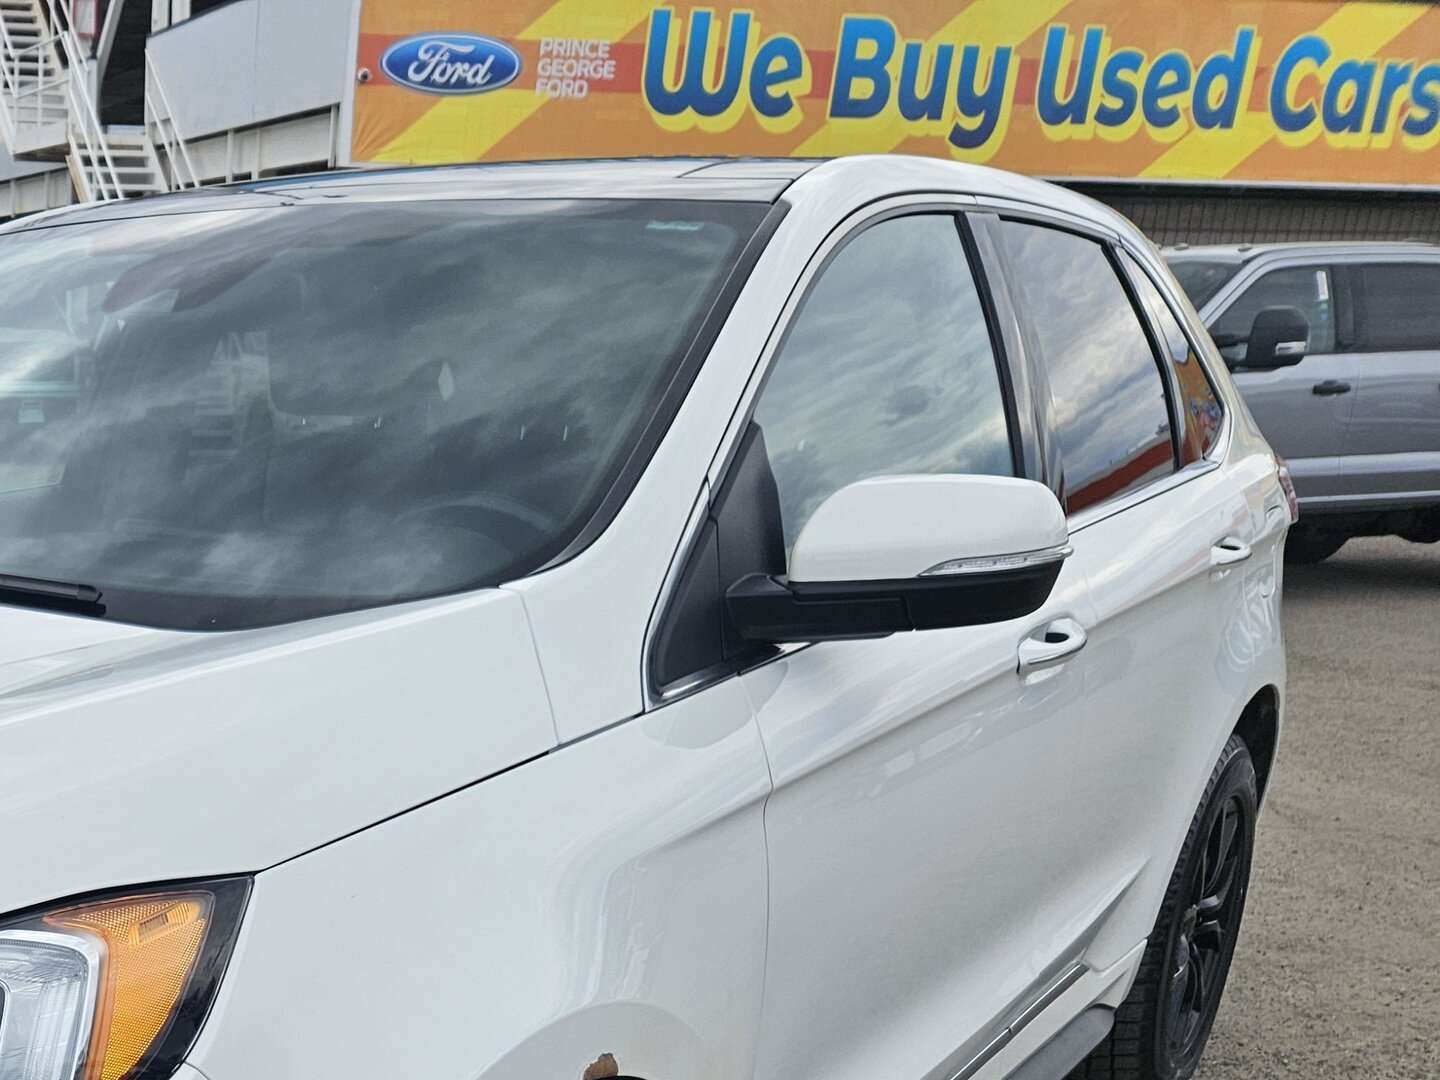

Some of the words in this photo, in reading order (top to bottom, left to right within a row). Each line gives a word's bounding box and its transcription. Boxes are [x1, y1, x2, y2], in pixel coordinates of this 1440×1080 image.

[539, 38, 610, 58] PRINCE
[407, 41, 495, 85] Ford
[537, 58, 615, 79] GEORGE
[535, 79, 588, 97] FORD
[643, 9, 803, 118] We
[828, 16, 1013, 149] Buy
[1036, 26, 1255, 129] Used
[1269, 34, 1440, 135] Cars
